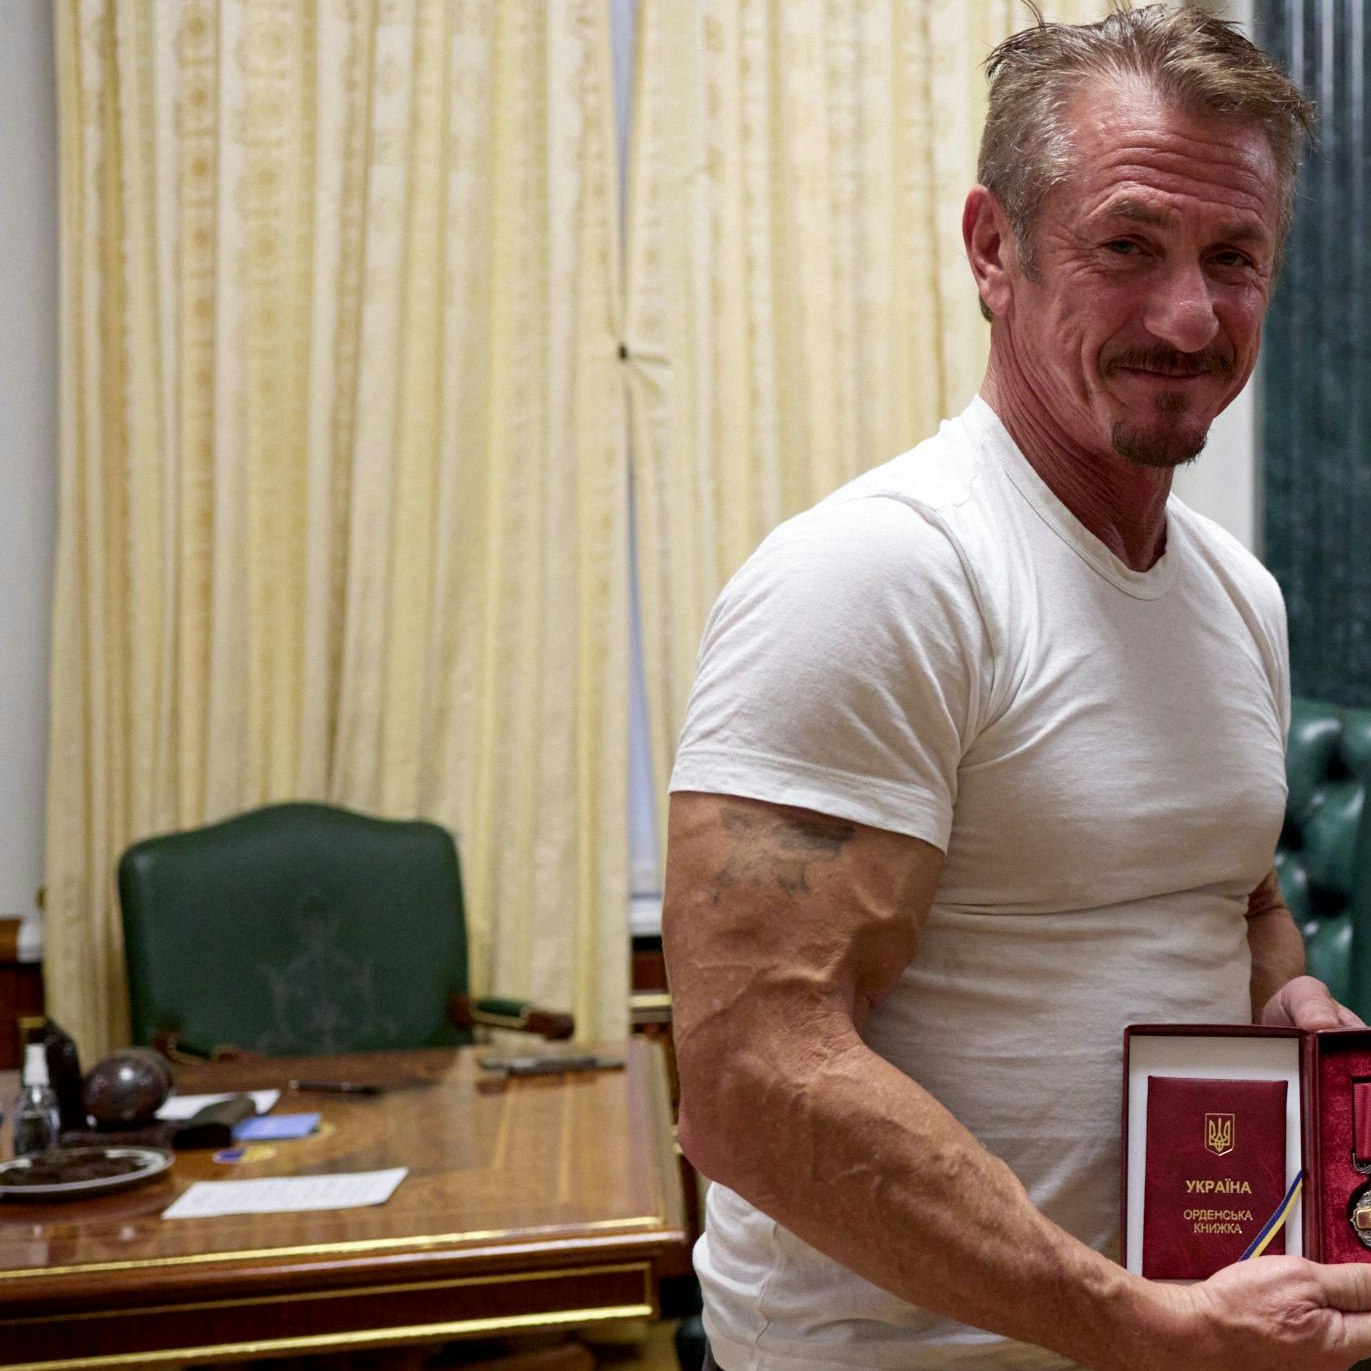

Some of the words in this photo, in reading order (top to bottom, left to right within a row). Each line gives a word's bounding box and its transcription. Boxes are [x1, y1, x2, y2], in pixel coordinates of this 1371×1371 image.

[1186, 1178, 1252, 1194] УКРАЇНА
[1183, 1209, 1253, 1221] ОРДЕНСЬКА
[1193, 1222, 1243, 1234] КНИЖКА
